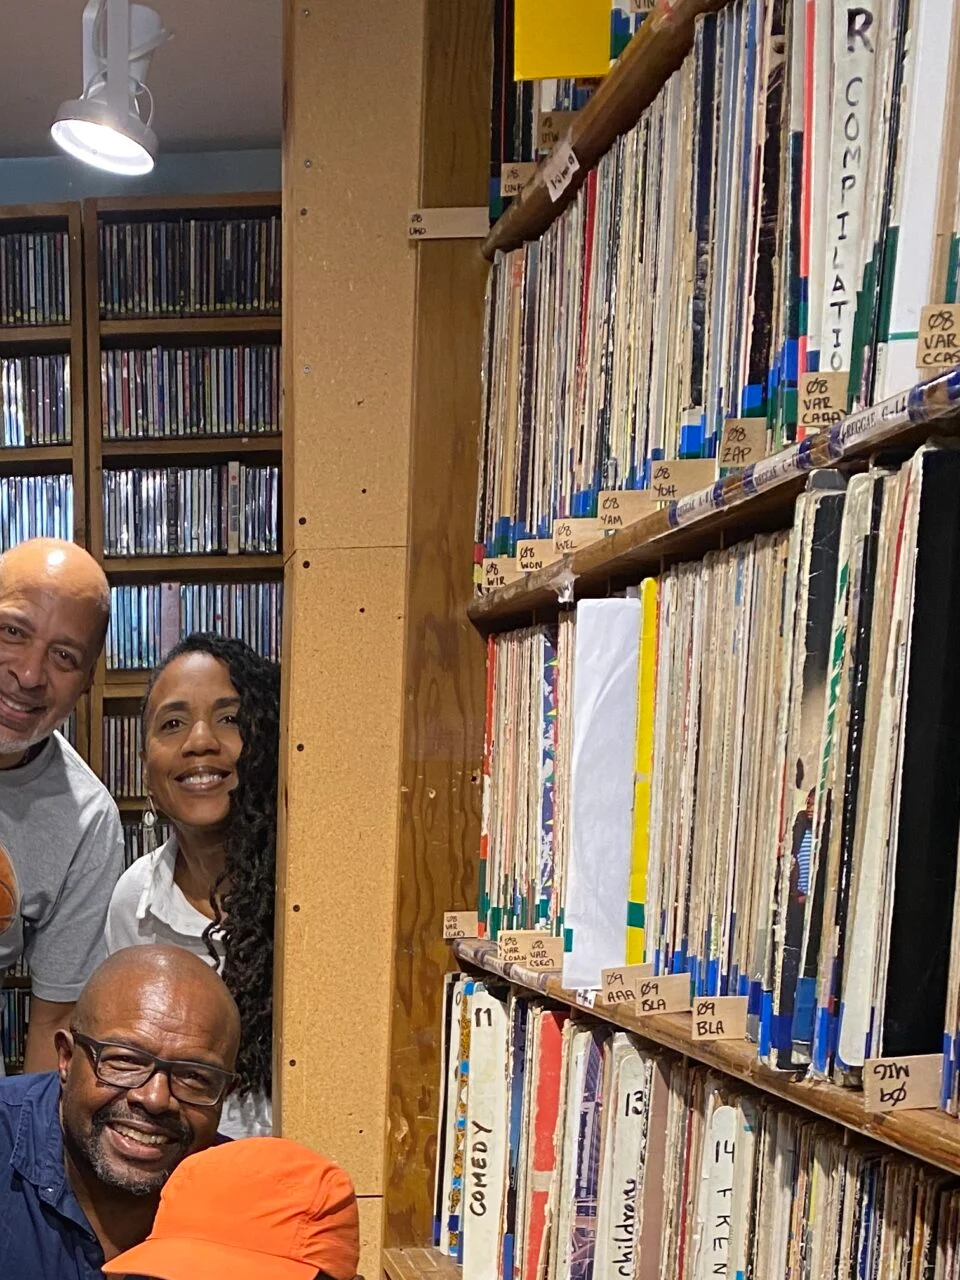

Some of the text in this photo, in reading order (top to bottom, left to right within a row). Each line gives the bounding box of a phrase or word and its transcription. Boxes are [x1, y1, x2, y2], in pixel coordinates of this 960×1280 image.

[924, 333, 960, 349] VAR
[803, 396, 833, 411] VAR
[722, 446, 752, 464] ZAP
[600, 514, 623, 526] YAM
[520, 560, 543, 570] WON
[487, 576, 506, 586] WIR
[529, 950, 549, 959] VAR
[607, 989, 637, 1003] AAA
[641, 998, 667, 1012] BLA
[695, 1020, 725, 1036] BLA
[873, 1062, 910, 1081] MIG
[714, 1139, 736, 1164] 14
[469, 1119, 494, 1217] COMEDY
